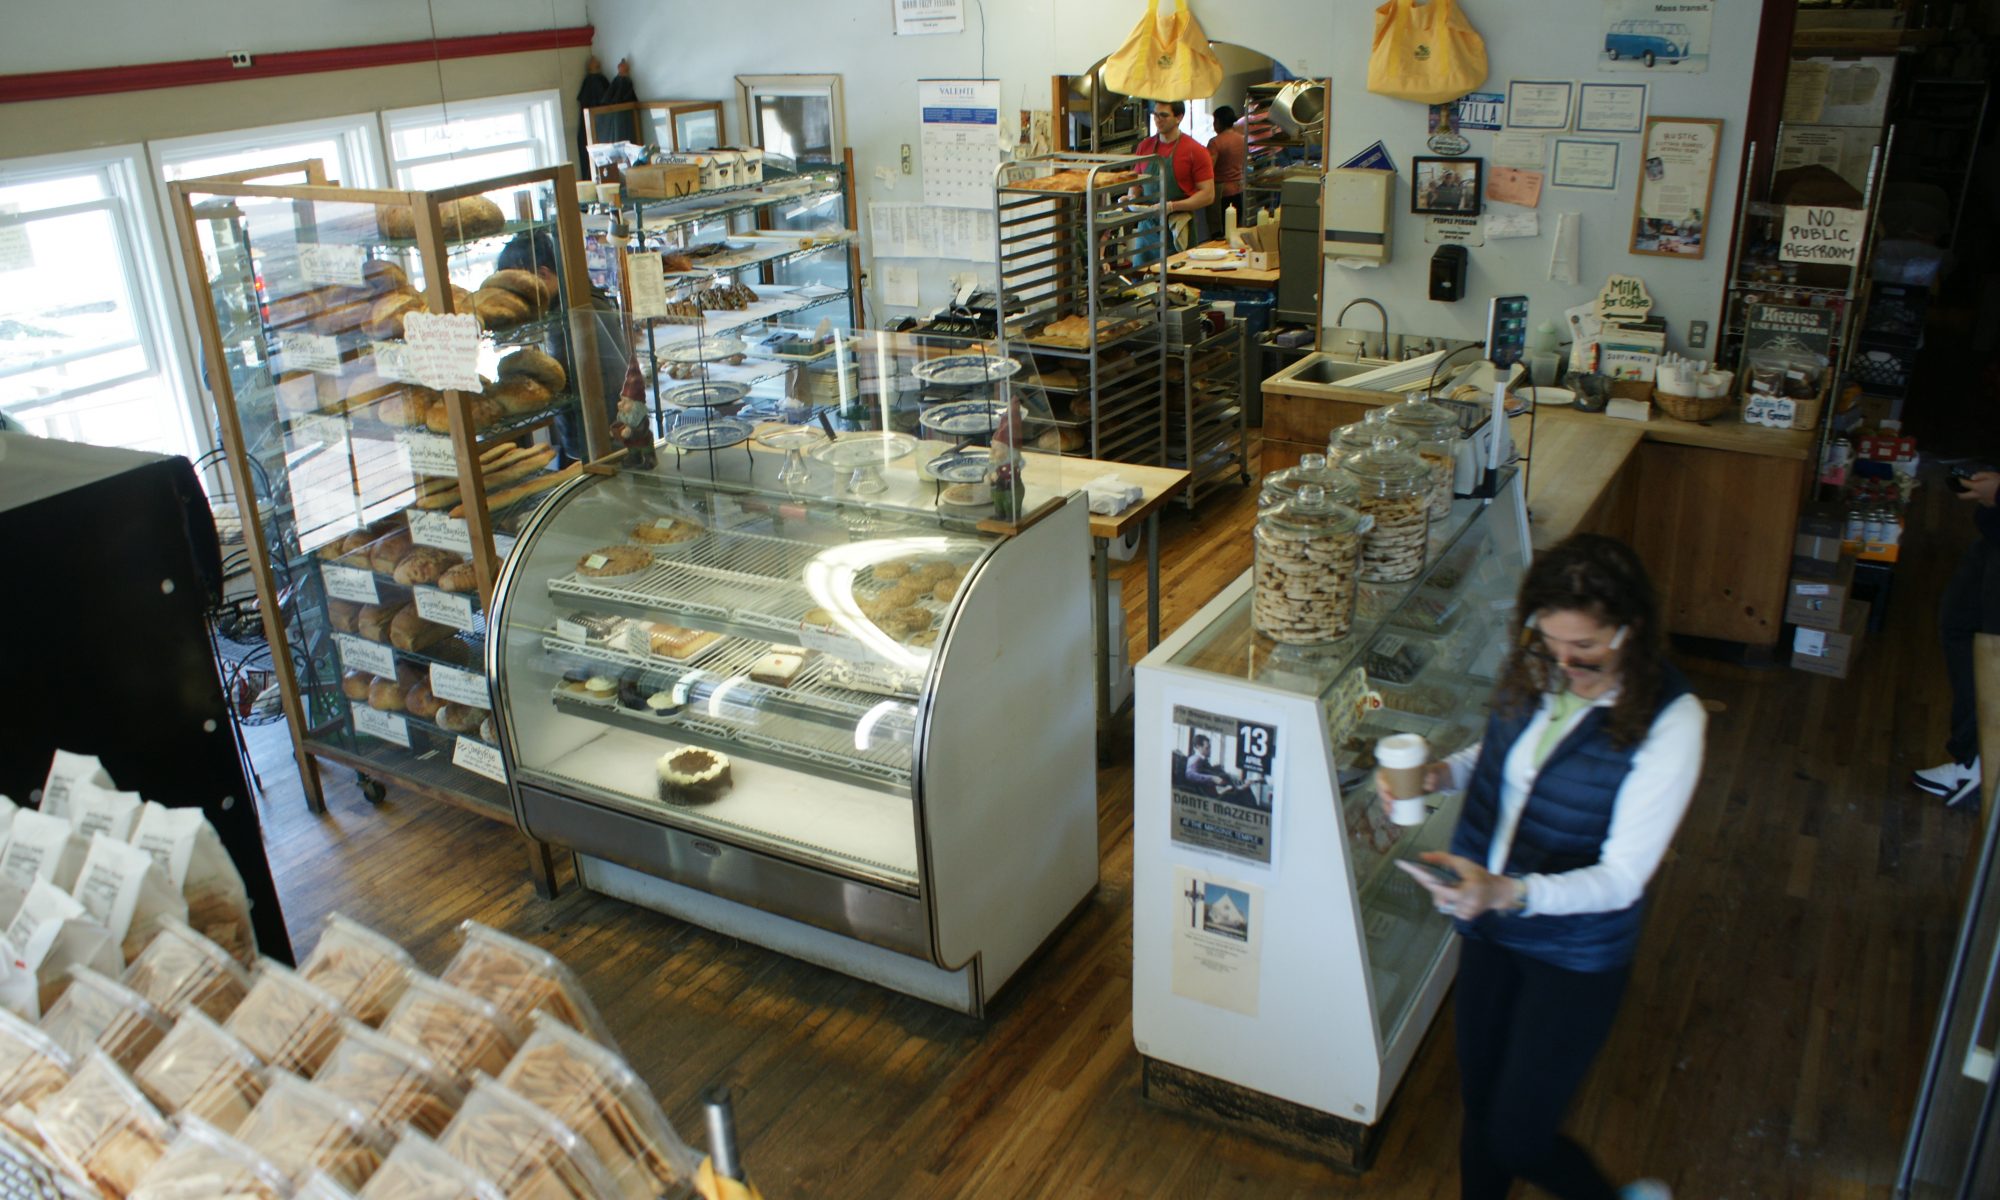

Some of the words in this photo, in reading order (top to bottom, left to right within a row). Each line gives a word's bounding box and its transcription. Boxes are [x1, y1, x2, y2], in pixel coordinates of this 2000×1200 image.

[1655, 4, 1677, 12] Mass
[939, 87, 974, 95] VALENTE
[1807, 208, 1835, 227] NO
[1789, 225, 1849, 241] PUBLIC
[1783, 242, 1856, 261] RESTROOM
[1610, 279, 1641, 297] Milk
[1601, 293, 1618, 310] for
[1619, 295, 1649, 309] Coffee
[1771, 323, 1800, 332] BACK
[1800, 326, 1829, 336] DOOR
[1240, 725, 1268, 758] 13
[1174, 792, 1209, 812] DANTE
[1213, 802, 1270, 827] MAZZETTI
